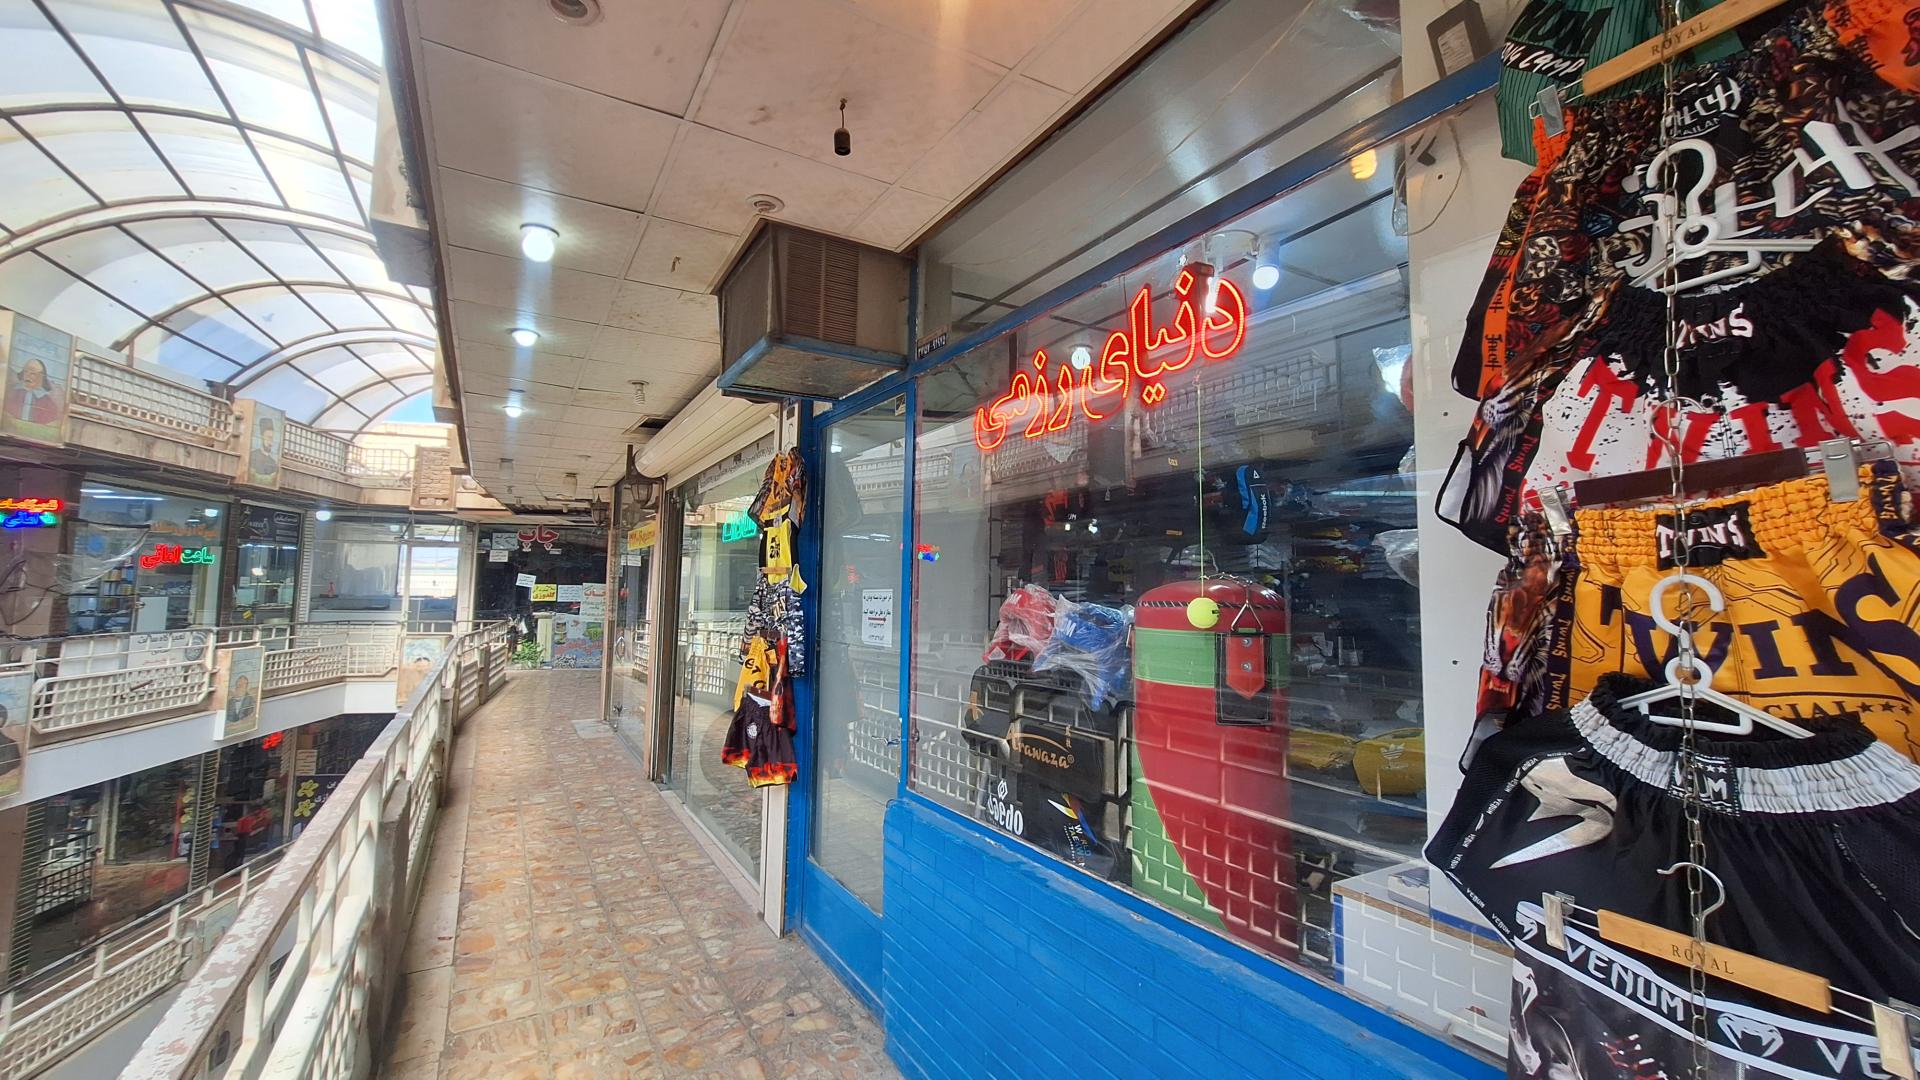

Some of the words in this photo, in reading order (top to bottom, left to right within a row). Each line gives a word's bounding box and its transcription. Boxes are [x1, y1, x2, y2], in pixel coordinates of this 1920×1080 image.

[1651, 21, 1710, 56] ROYAL
[1080, 268, 1248, 420] دنیای
[974, 349, 1074, 451] رزمی
[181, 547, 215, 565] ساعت
[516, 524, 560, 552] چاپ
[1552, 618, 1572, 659] TWINS
[1546, 672, 1567, 711] TWINS
[987, 795, 1024, 837] daedo
[1671, 943, 1736, 975] ROYAL
[1565, 937, 1685, 1022] VENUM
